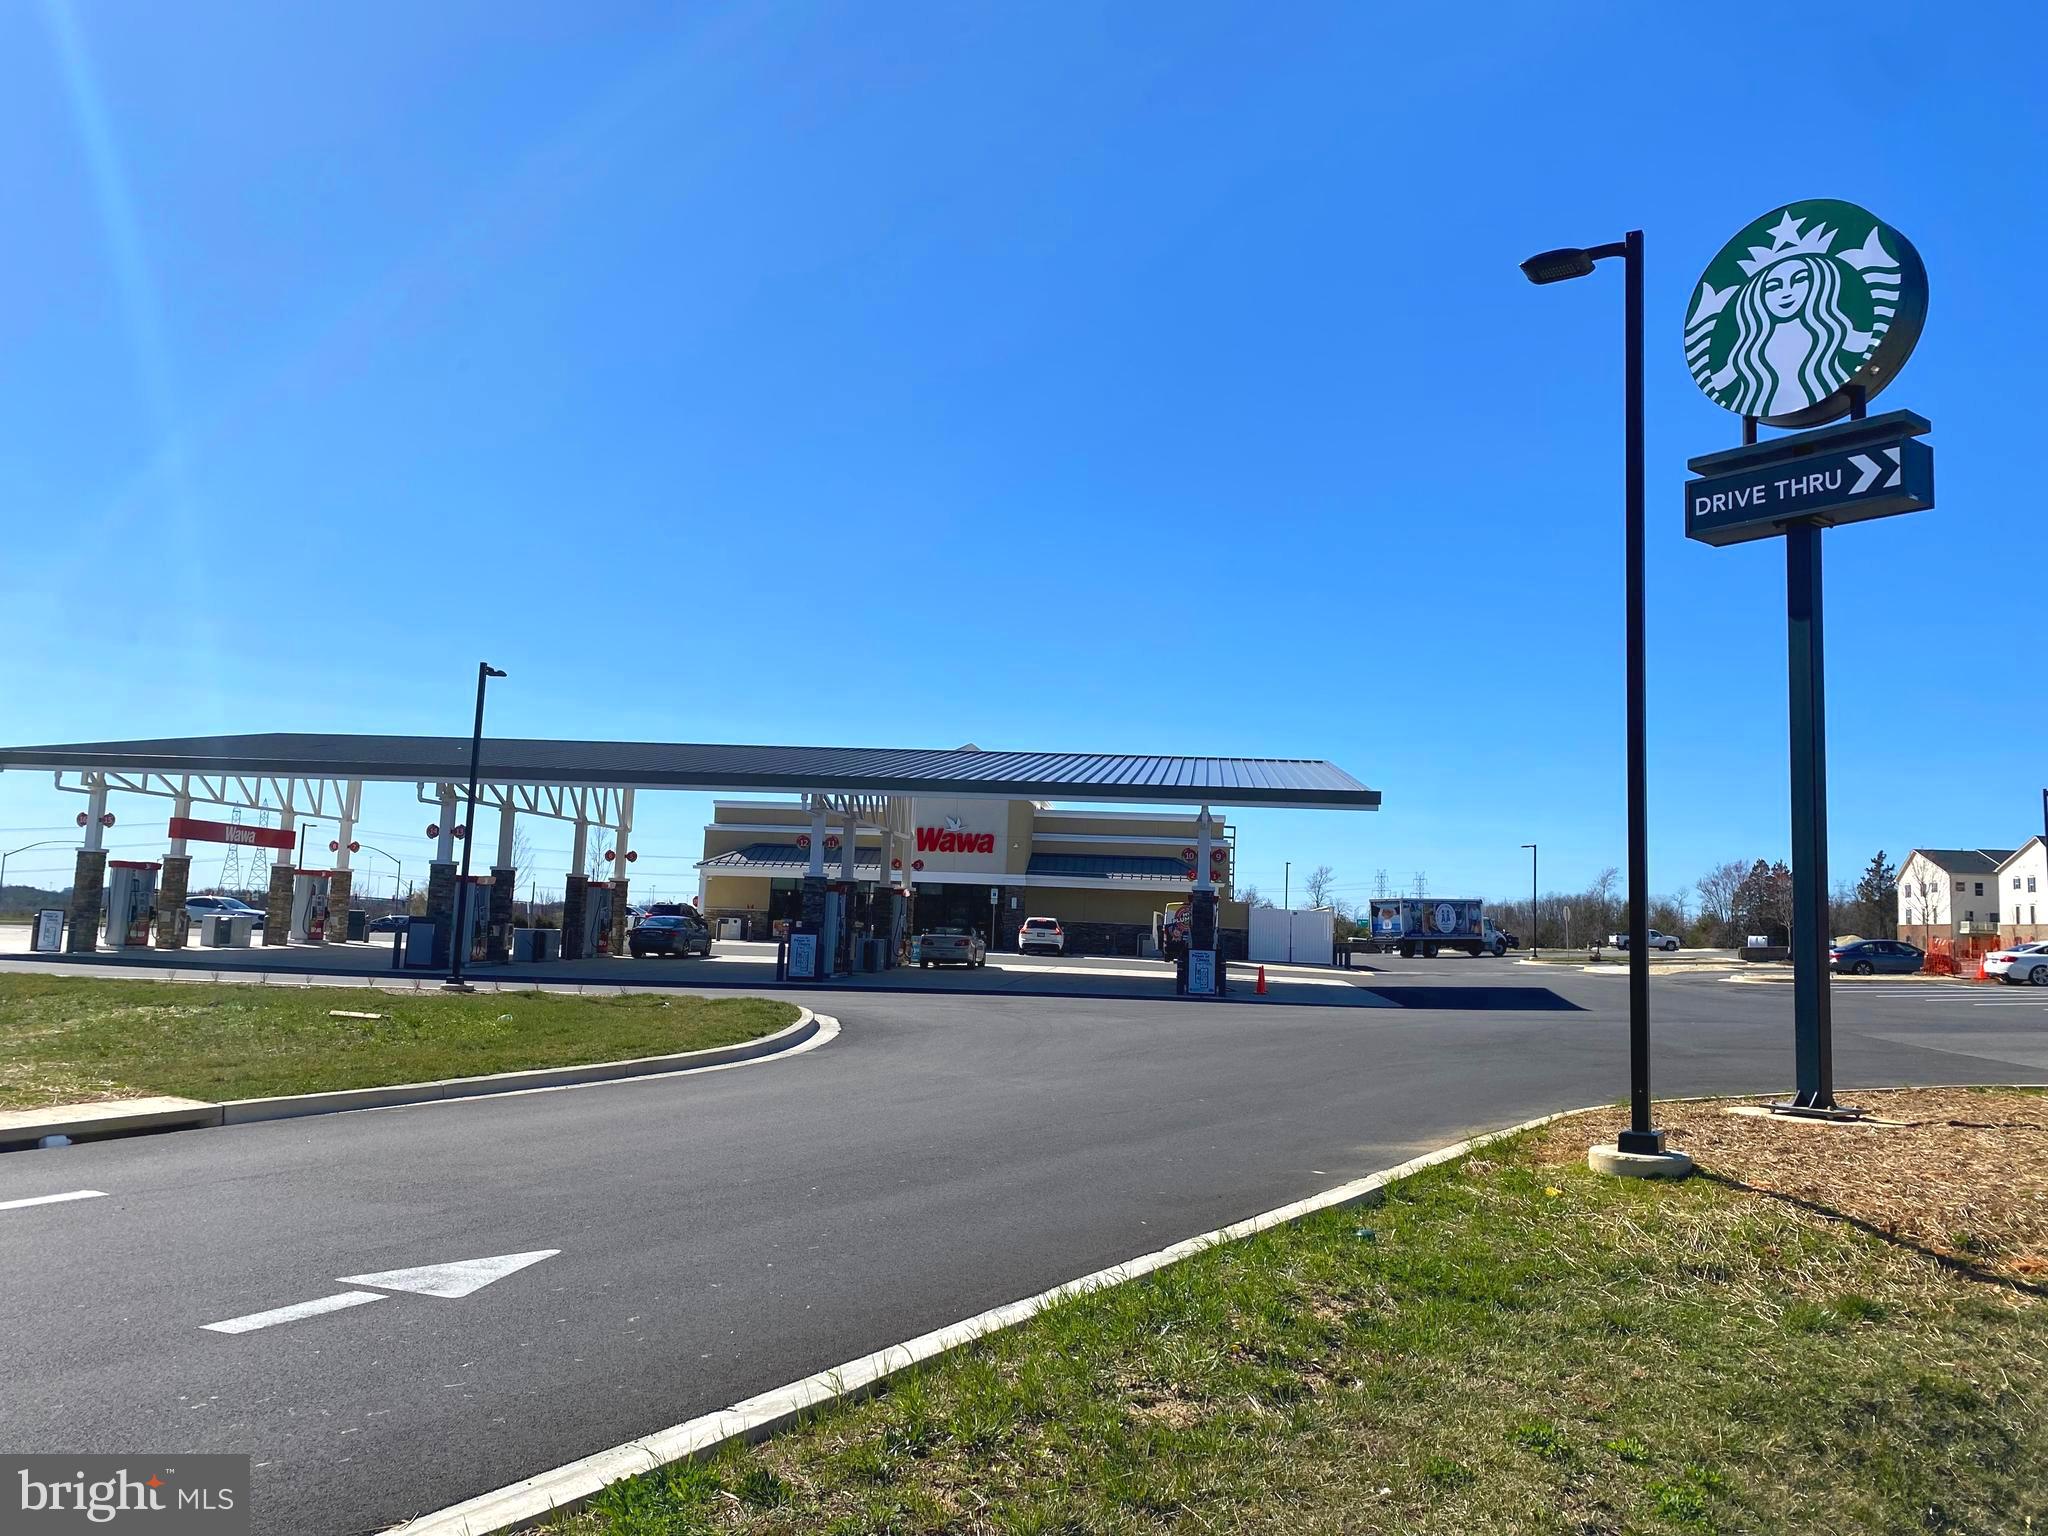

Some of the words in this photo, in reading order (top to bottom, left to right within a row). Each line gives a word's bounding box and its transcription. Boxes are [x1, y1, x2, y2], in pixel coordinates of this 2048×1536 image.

[1694, 484, 1766, 517] DRIVE
[1774, 468, 1842, 501] THRU
[225, 825, 257, 843] Wawa
[916, 827, 995, 853] Wawa
